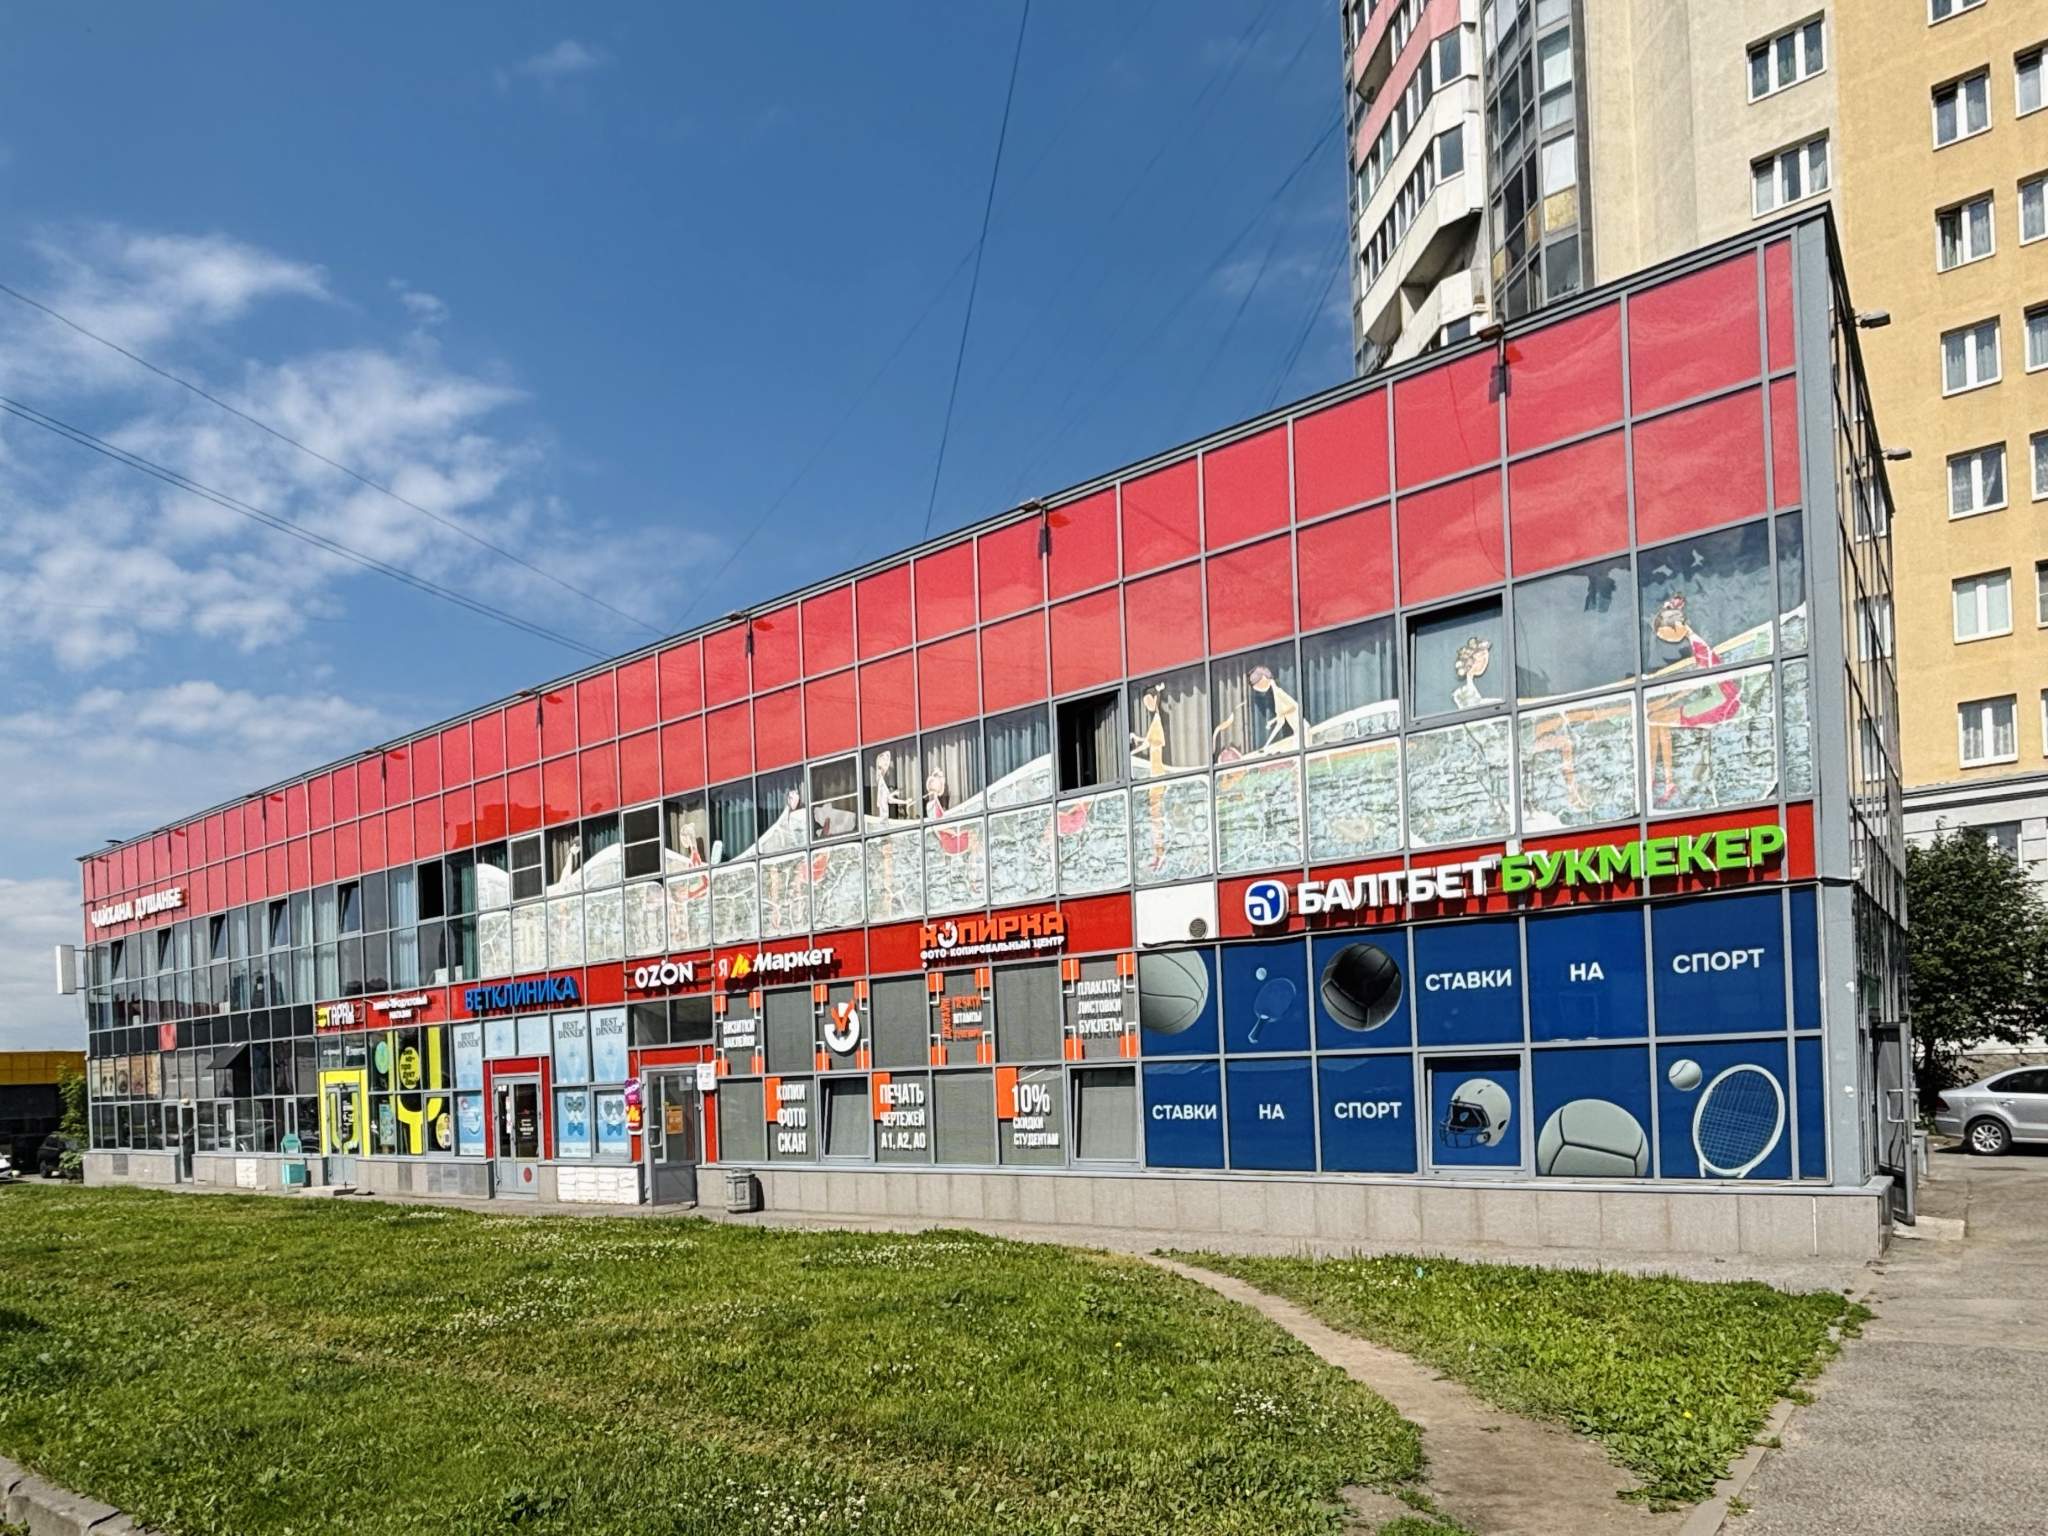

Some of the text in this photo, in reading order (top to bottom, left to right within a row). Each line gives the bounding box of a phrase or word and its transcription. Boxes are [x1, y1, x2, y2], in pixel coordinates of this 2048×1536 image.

[1297, 825, 1787, 915] БАЛТБЕТ БУКМЕКЕР
[135, 887, 182, 921] ДУШАНБЕ
[1032, 935, 1065, 949] ЦЕНТР
[753, 948, 834, 976] Маркет
[1425, 948, 1765, 992] СТАВКИ НА СПОРТ
[634, 959, 694, 989] OZON
[465, 976, 578, 1011] ВЕТКЛИНИКА
[1077, 979, 1121, 996] ПЛАКАТЫ
[1077, 998, 1122, 1015] ЛИСТОВКИ
[1078, 1017, 1123, 1034] БУКЛЕТЫ
[776, 1083, 806, 1101] КОПИИ
[879, 1083, 925, 1104] ПЕЧАТЬ
[1011, 1084, 1051, 1113] 10%
[776, 1107, 807, 1128] ФОТО
[879, 1108, 926, 1126] ЧЕРТЕЖЕЙ
[1152, 1102, 1402, 1120] СТАВКИ НА СПОРТ
[1012, 1116, 1044, 1130] СКИДКИ
[777, 1132, 807, 1153] СКАН
[1013, 1133, 1060, 1147] СТУДЕНТАМ
